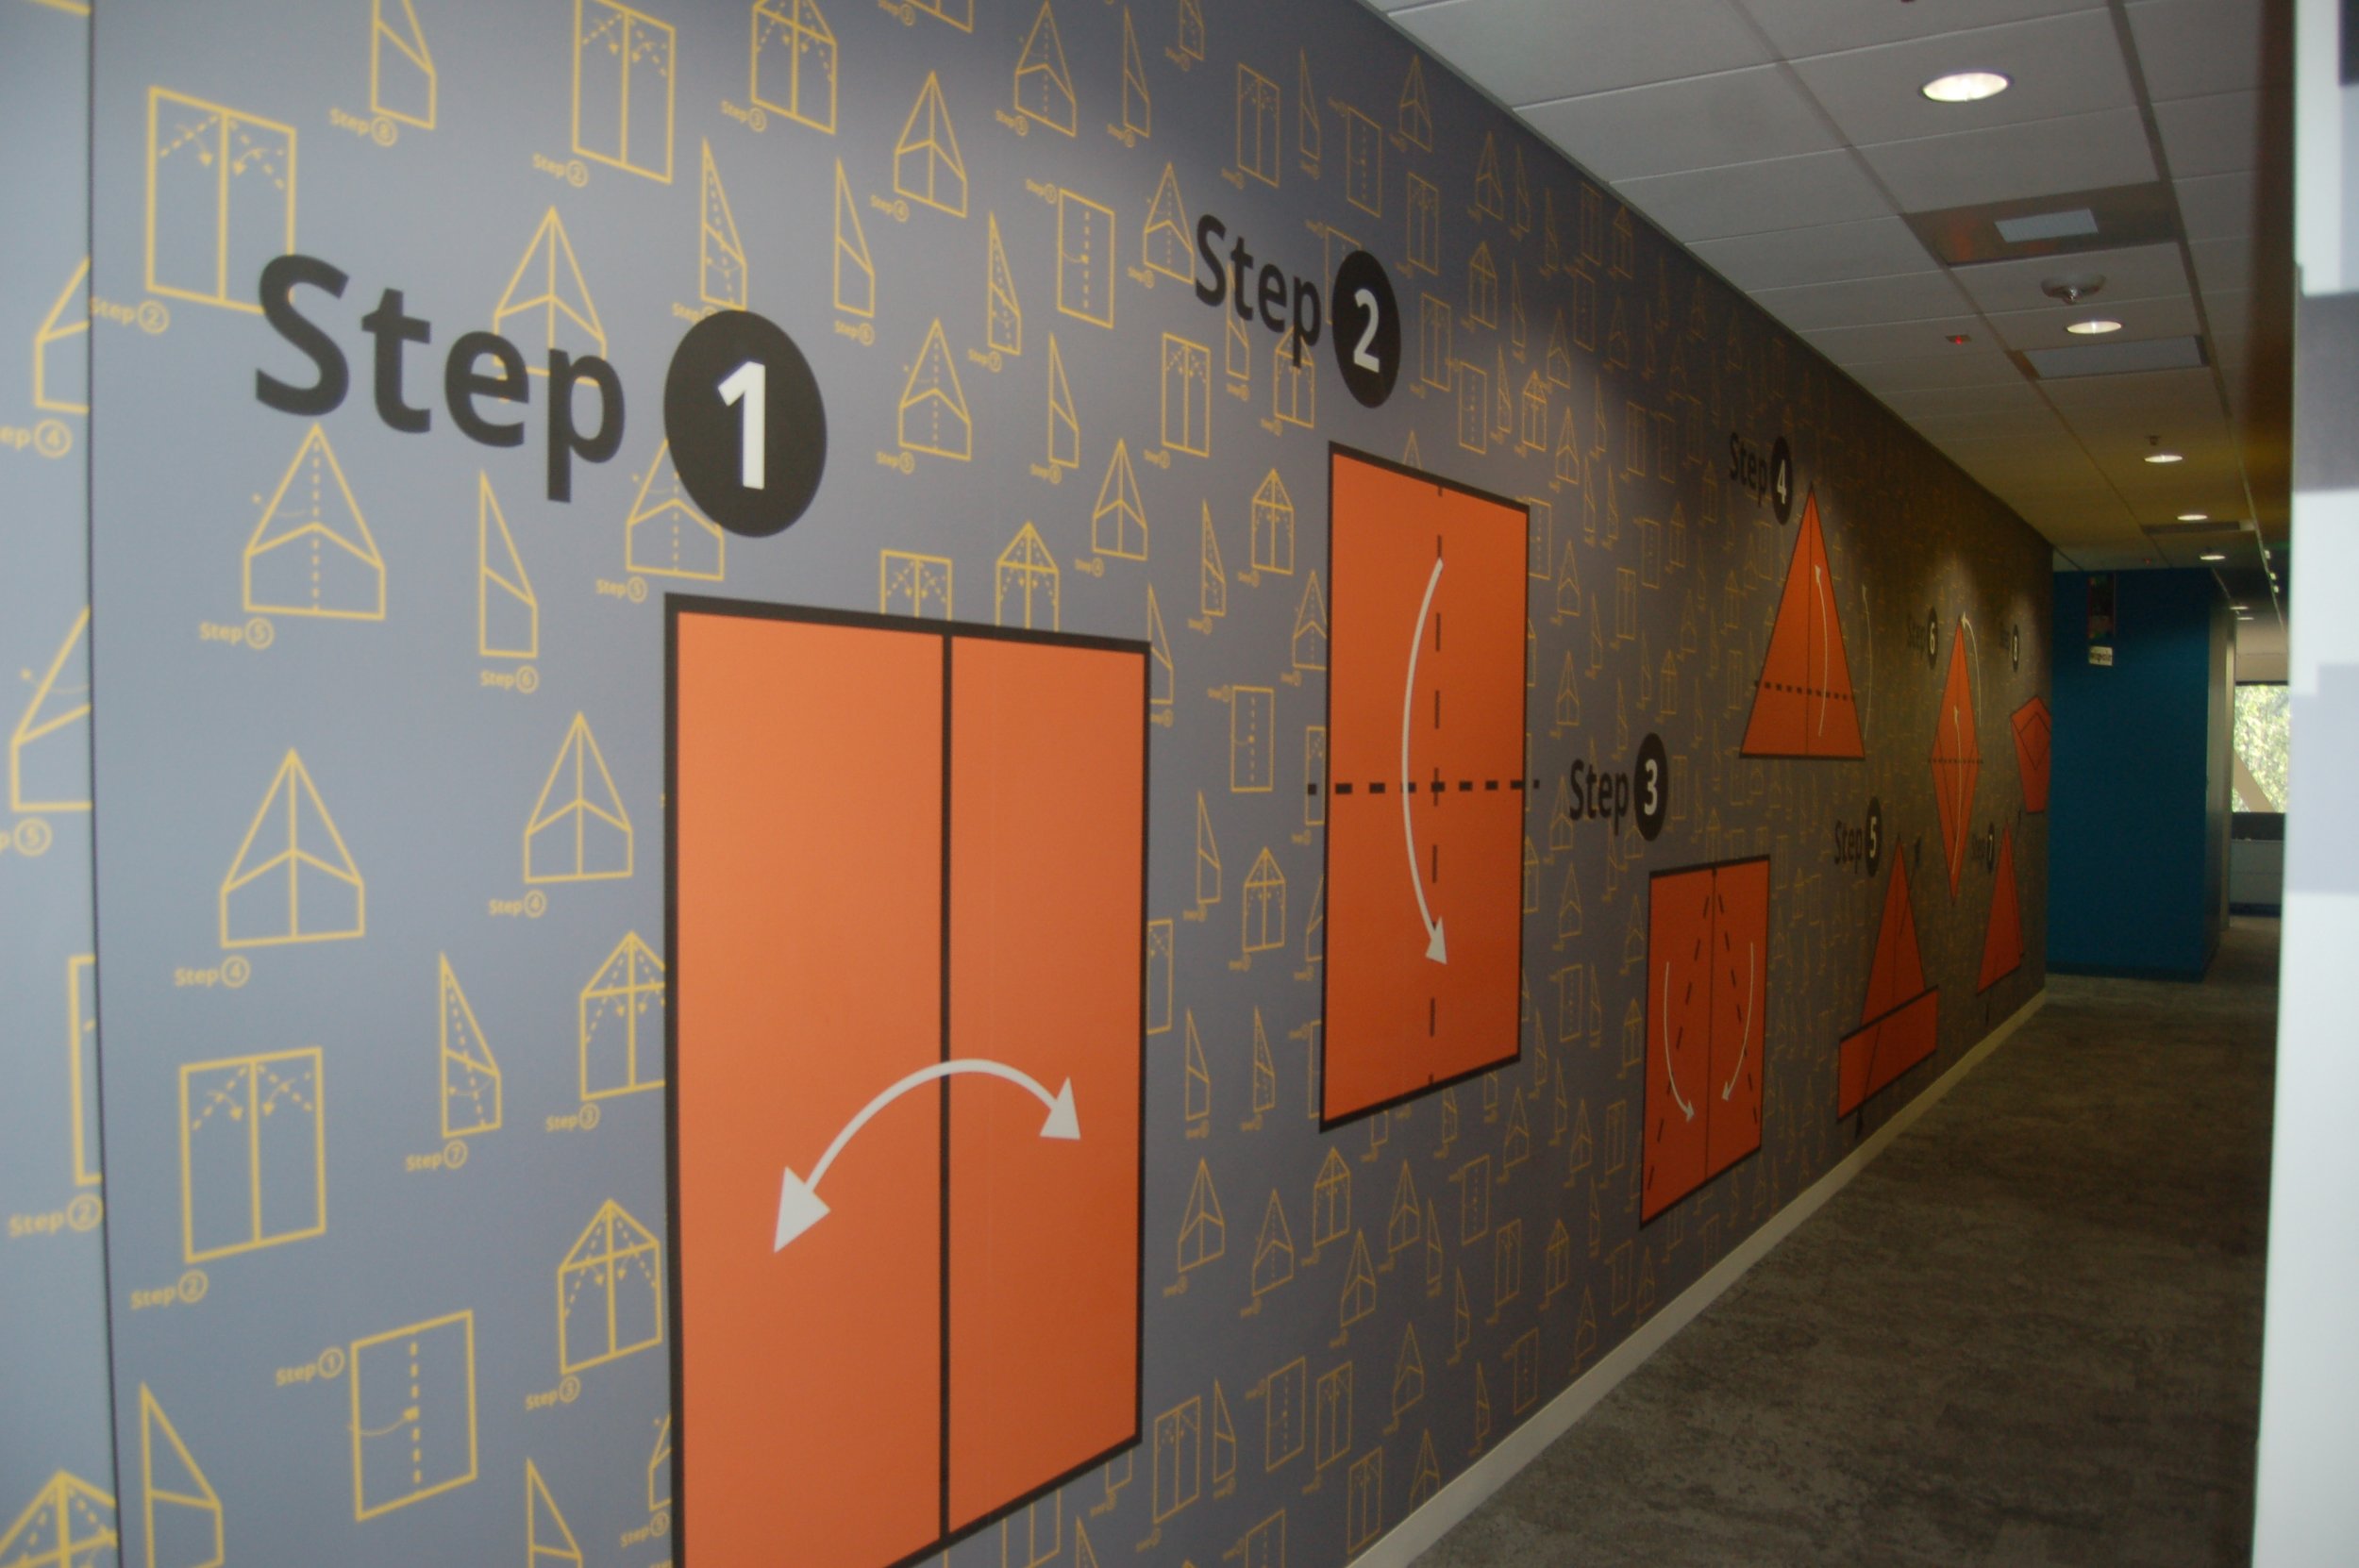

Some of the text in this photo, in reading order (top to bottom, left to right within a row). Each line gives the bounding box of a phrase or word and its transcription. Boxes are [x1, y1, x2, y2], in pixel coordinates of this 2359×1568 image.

[1196, 215, 1380, 373] Step 2
[257, 255, 765, 503] Step 1
[1729, 431, 1767, 509] Step
[198, 621, 243, 645] Step
[1569, 758, 1658, 836] Step 3
[1833, 819, 1863, 875] Step
[174, 966, 218, 988] Step
[8, 1210, 64, 1238] Step
[130, 1286, 176, 1310] Step
[276, 1362, 317, 1388] Step
